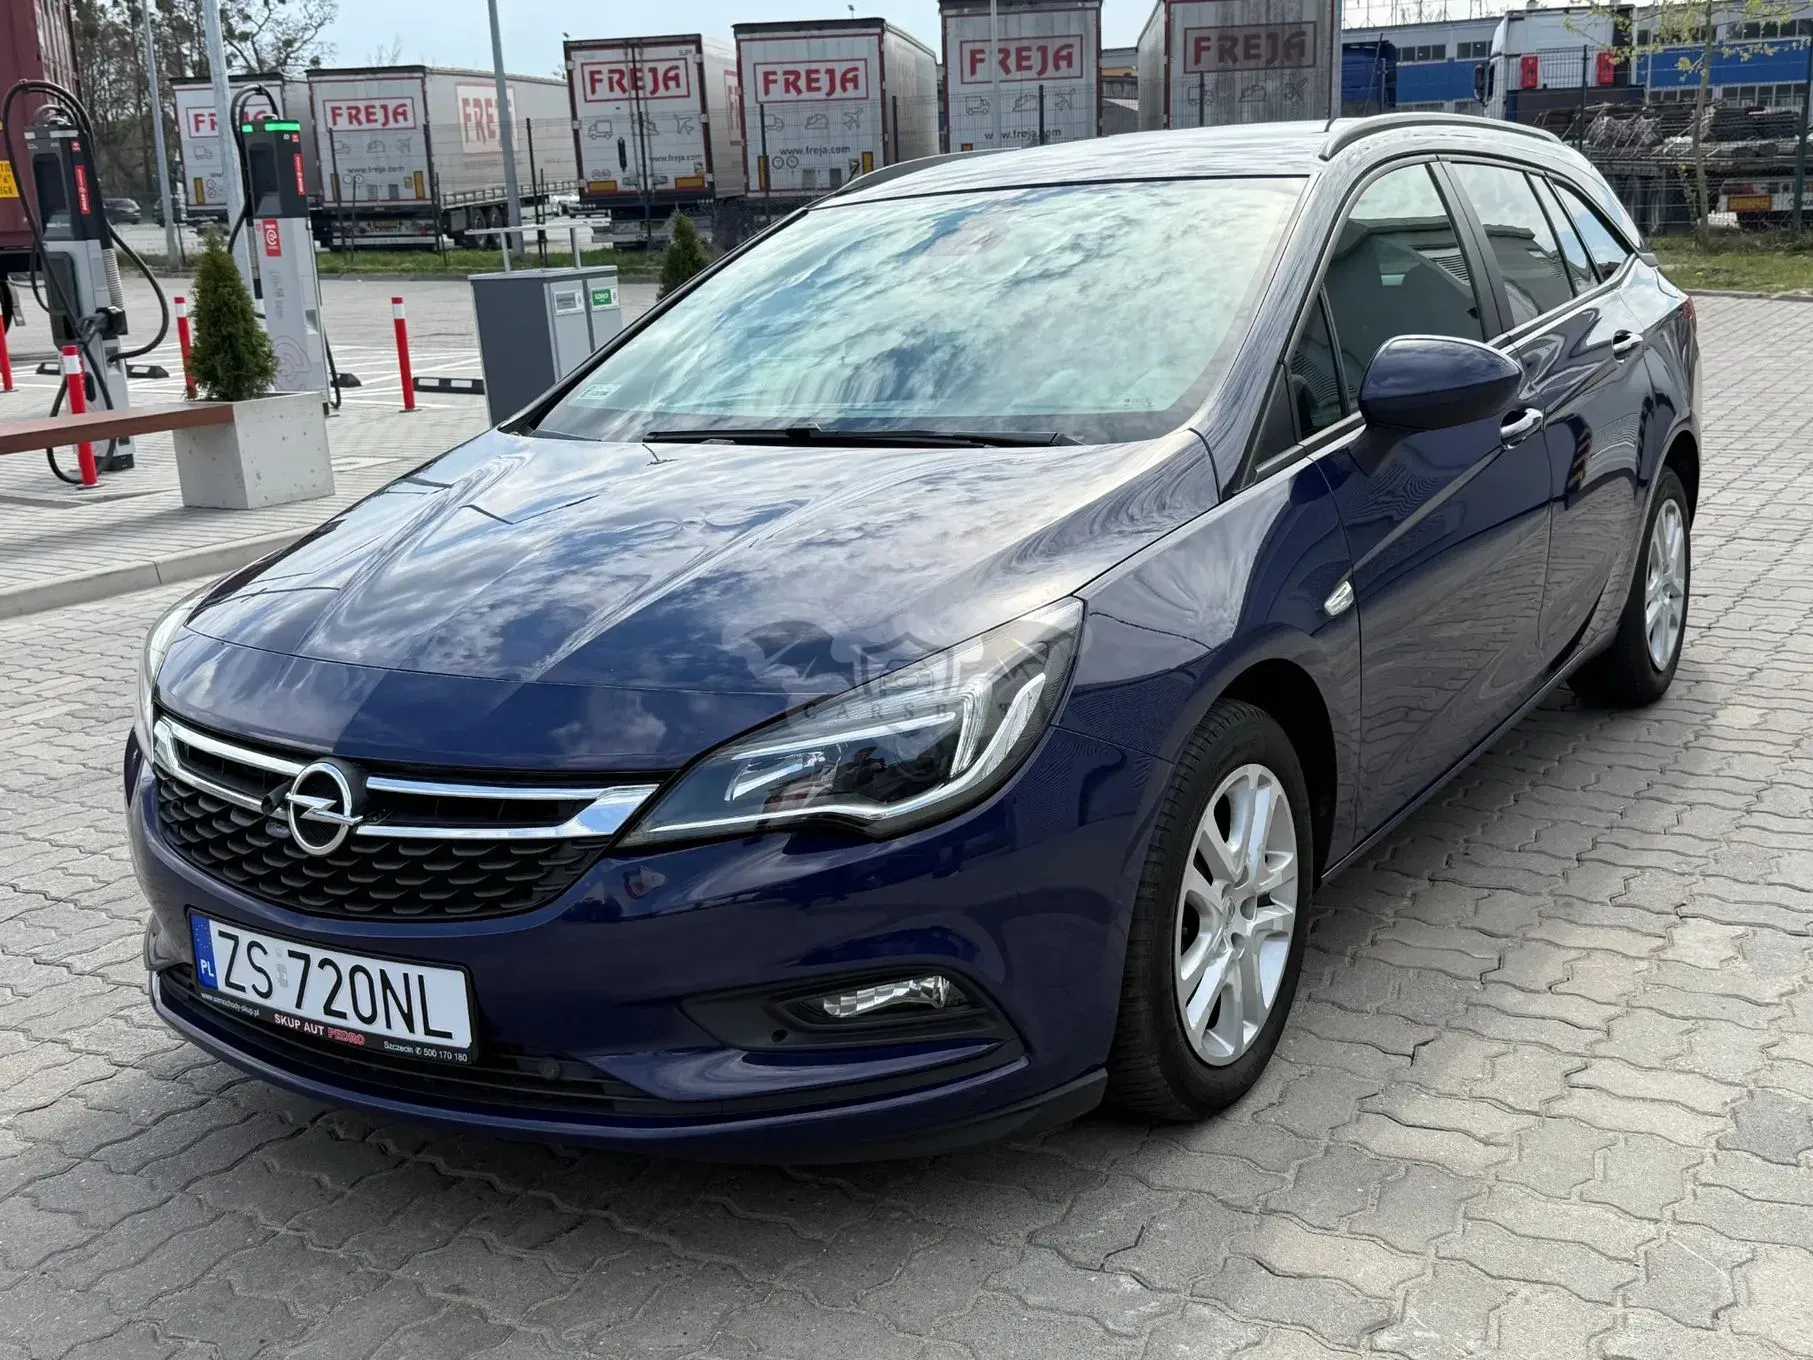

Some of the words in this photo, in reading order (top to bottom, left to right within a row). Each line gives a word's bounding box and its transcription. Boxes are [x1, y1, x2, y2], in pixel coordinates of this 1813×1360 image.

[969, 43, 1074, 77] FREJA
[1193, 30, 1307, 66] FREJA
[588, 65, 681, 96] FREJA
[762, 66, 859, 97] FREJA
[330, 103, 409, 127] FREJA
[461, 97, 512, 145] FRE
[984, 128, 1062, 140] ww.frejaom
[780, 145, 851, 157] www.freja.com
[200, 960, 215, 978] PL
[218, 930, 273, 999] ZS
[287, 949, 453, 1040] 720NL
[274, 1013, 301, 1030] SKUP
[303, 1022, 325, 1037] AUT
[327, 1027, 366, 1046] PEDRO
[383, 1040, 414, 1054] Szczecin
[423, 1048, 438, 1058] 500
[439, 1050, 453, 1060] 170
[454, 1052, 468, 1063] 180
